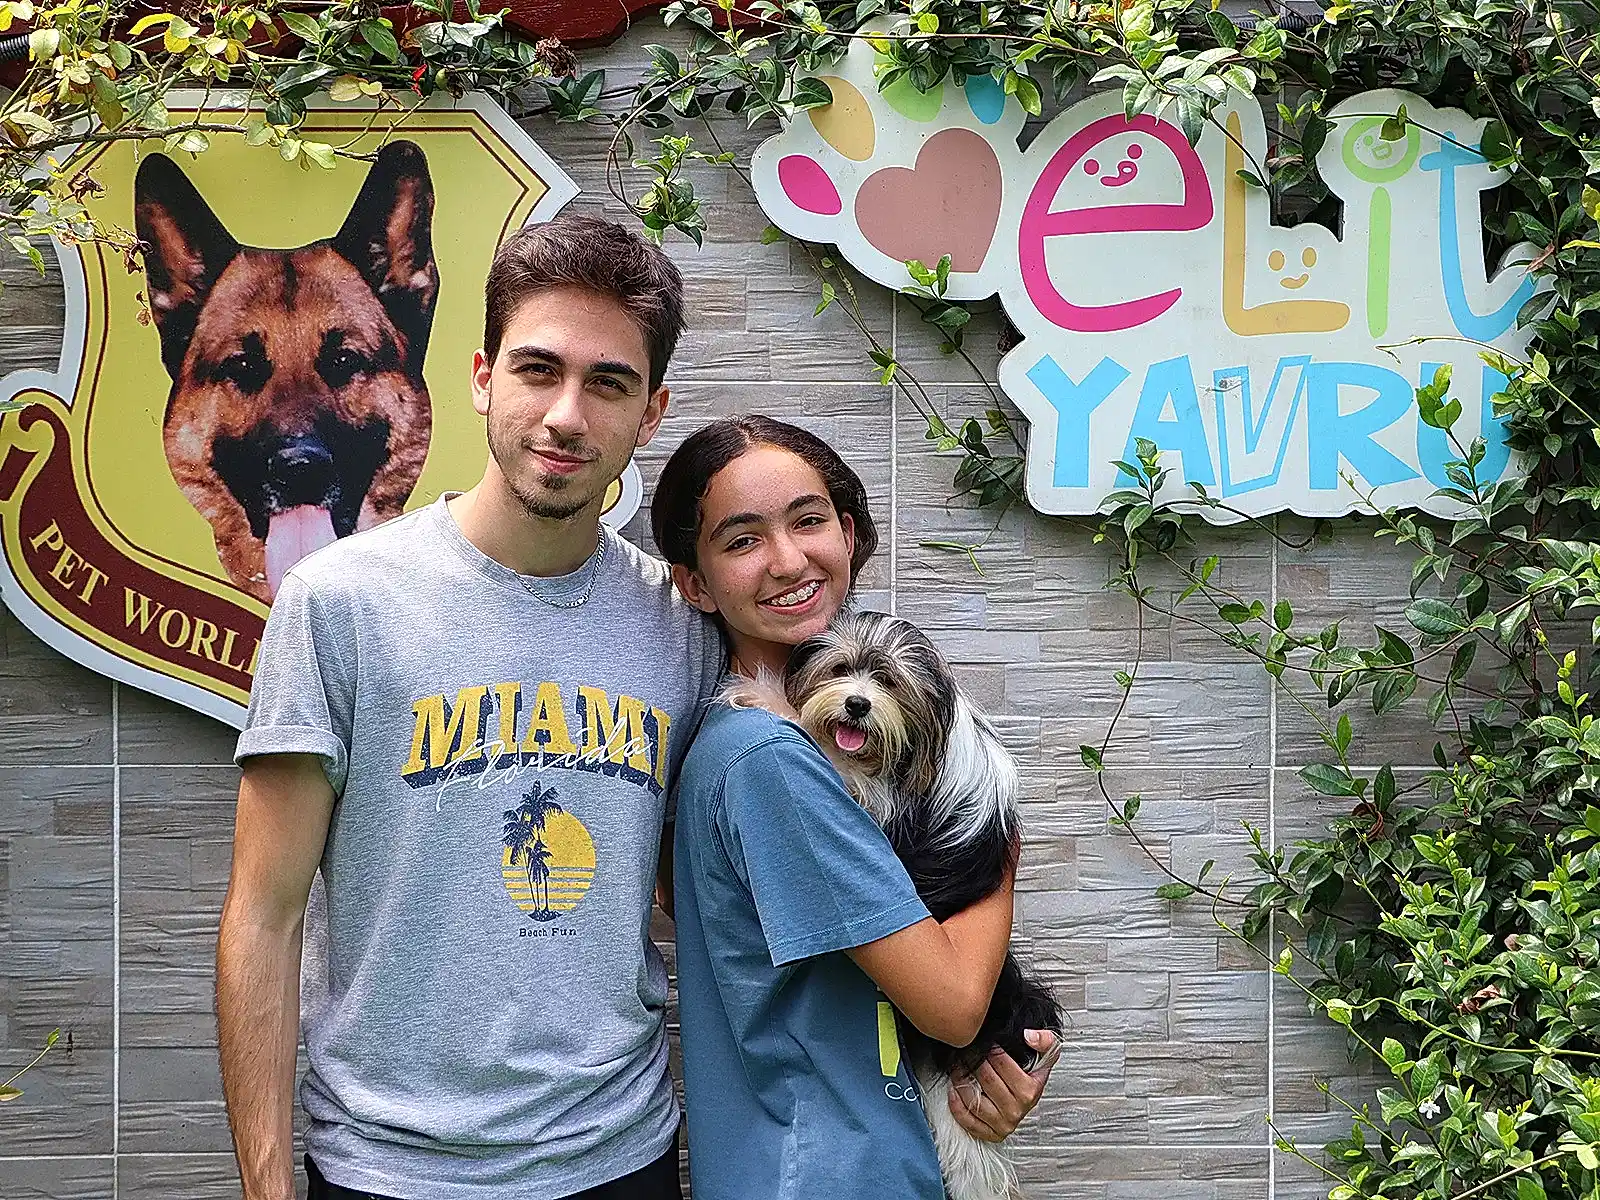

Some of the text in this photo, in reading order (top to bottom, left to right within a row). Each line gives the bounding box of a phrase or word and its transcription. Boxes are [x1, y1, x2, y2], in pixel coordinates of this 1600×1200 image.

[1026, 353, 1512, 498] YAVRU
[28, 518, 110, 607] PET
[400, 681, 671, 798] MIAMI
[518, 927, 577, 938] Beach Fun
